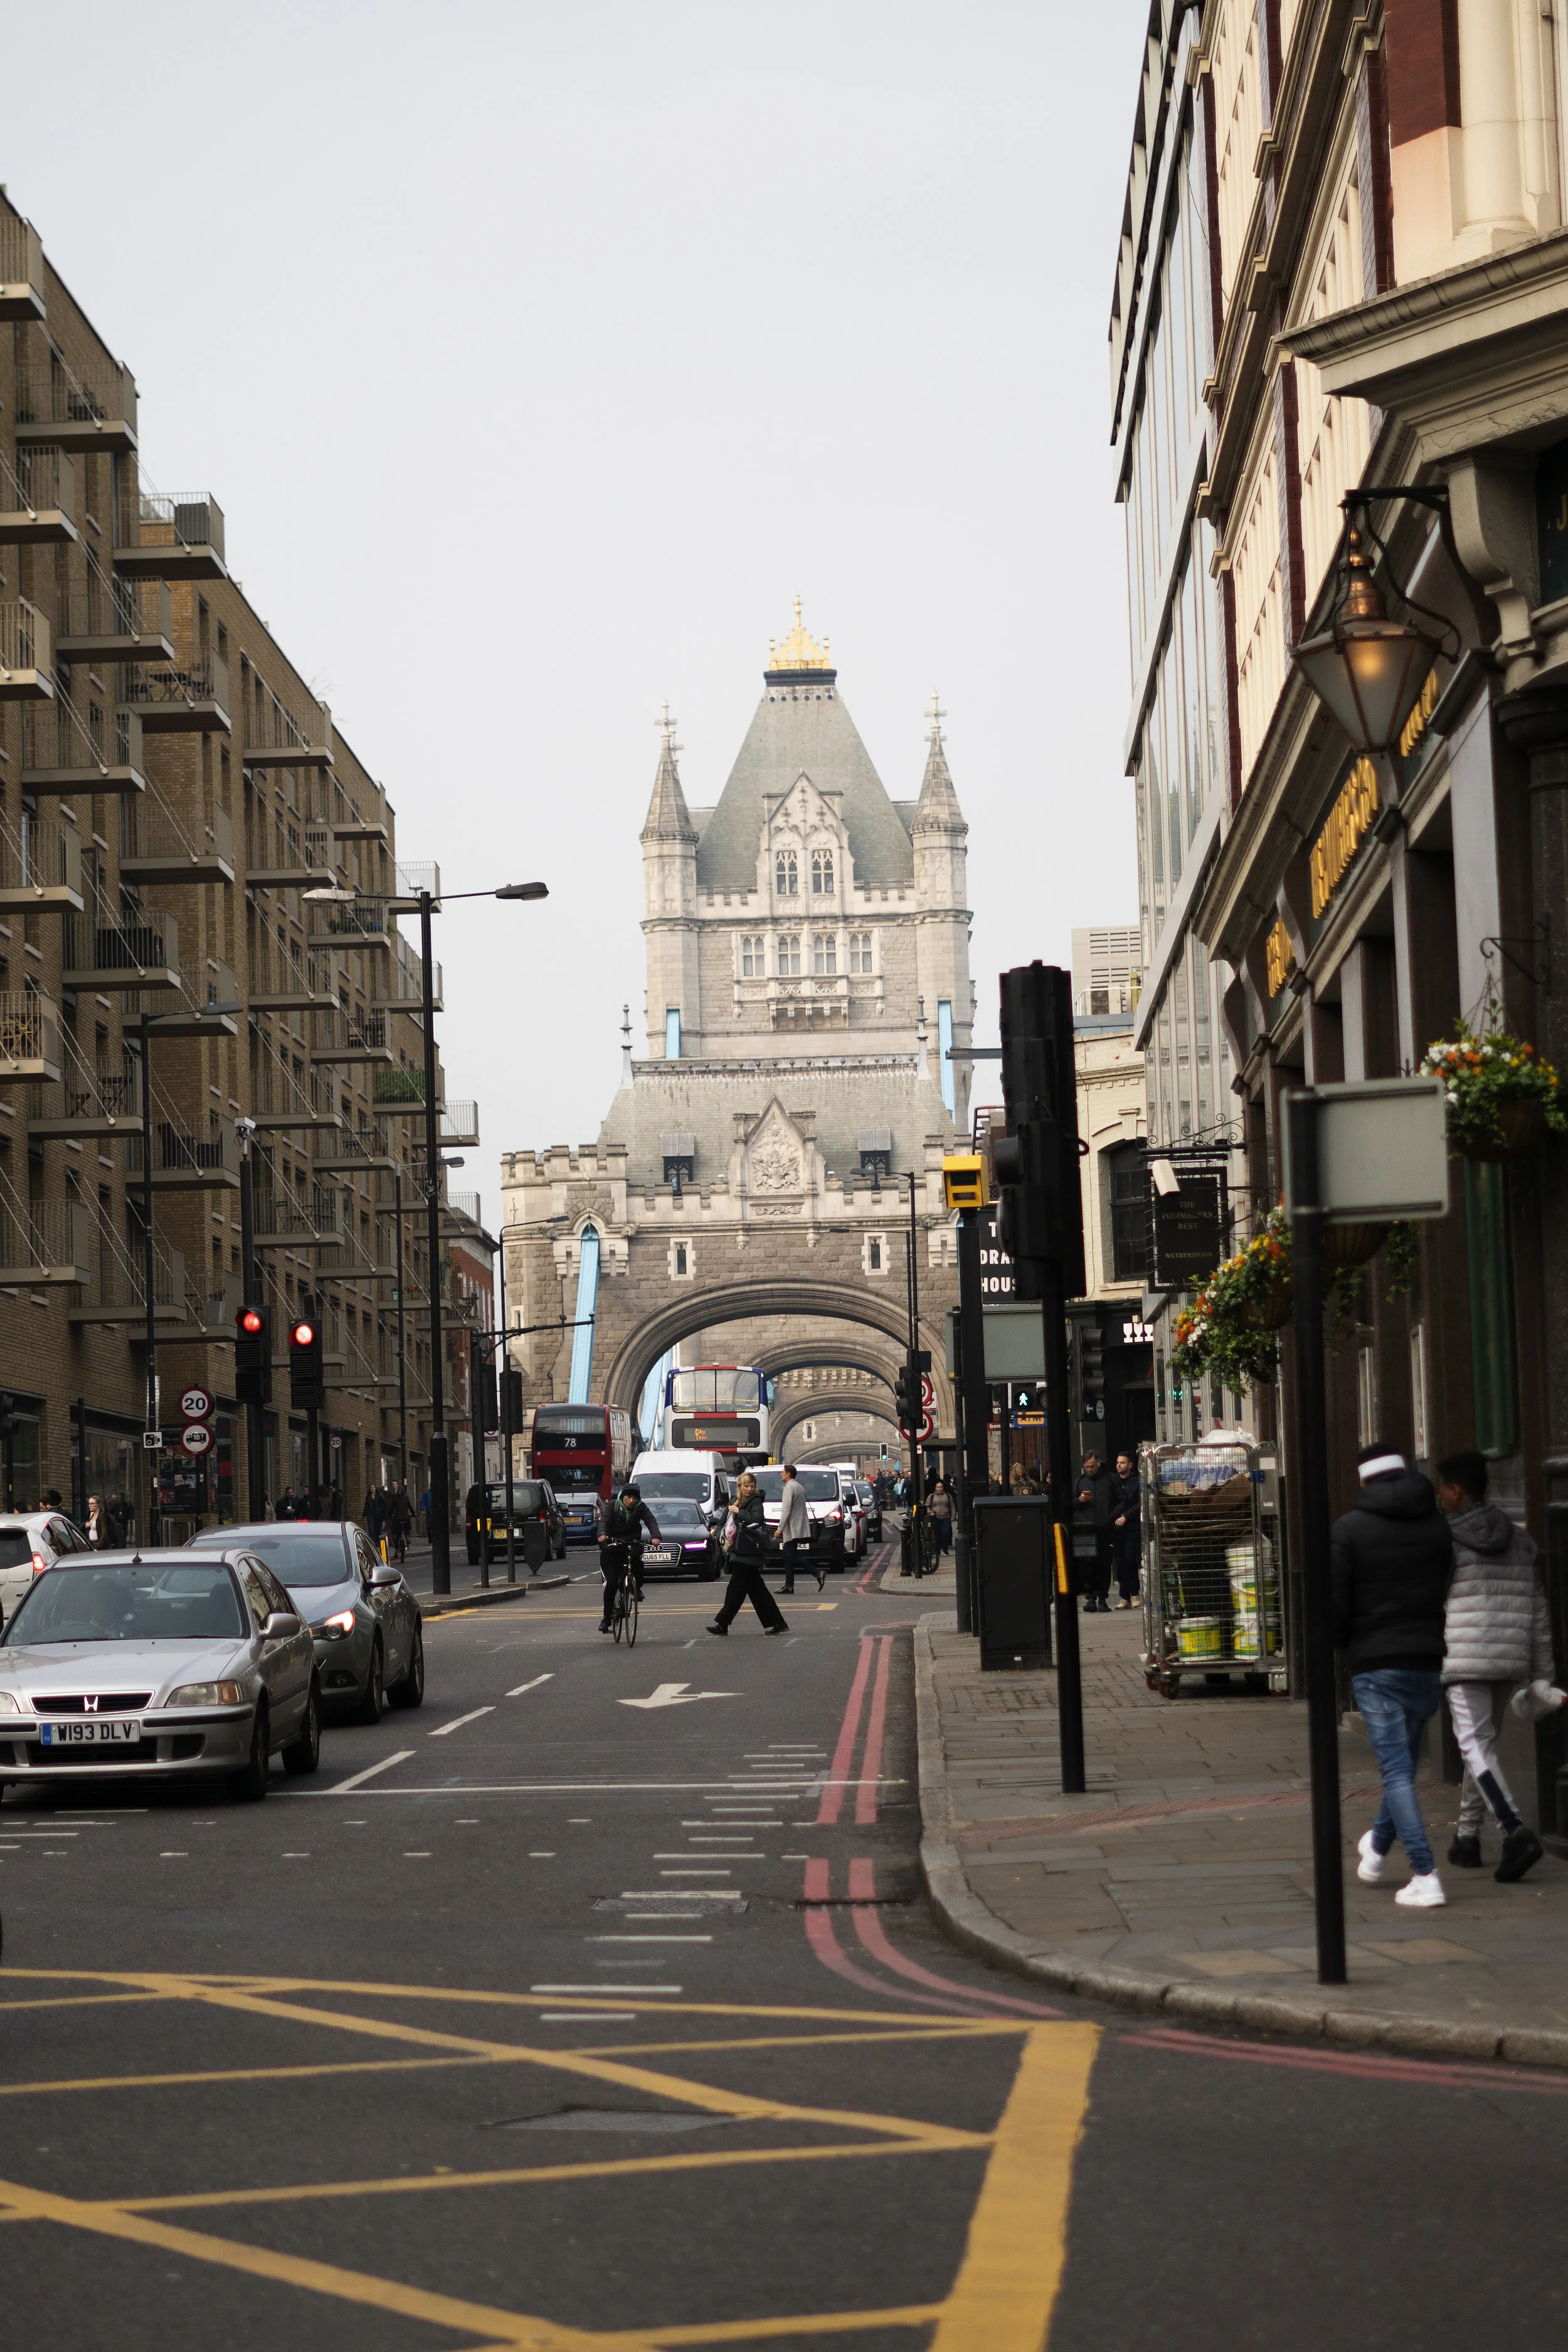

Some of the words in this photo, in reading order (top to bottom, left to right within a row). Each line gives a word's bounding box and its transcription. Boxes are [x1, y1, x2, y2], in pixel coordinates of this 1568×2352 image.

[1162, 1211, 1213, 1219] POMMELERS
[981, 1277, 1017, 1293] HOUS
[184, 1397, 206, 1411] 20
[1020, 1413, 1041, 1422] ATM
[564, 1438, 577, 1448] 78
[58, 1724, 94, 1742] W193
[100, 1723, 132, 1740] DLV
